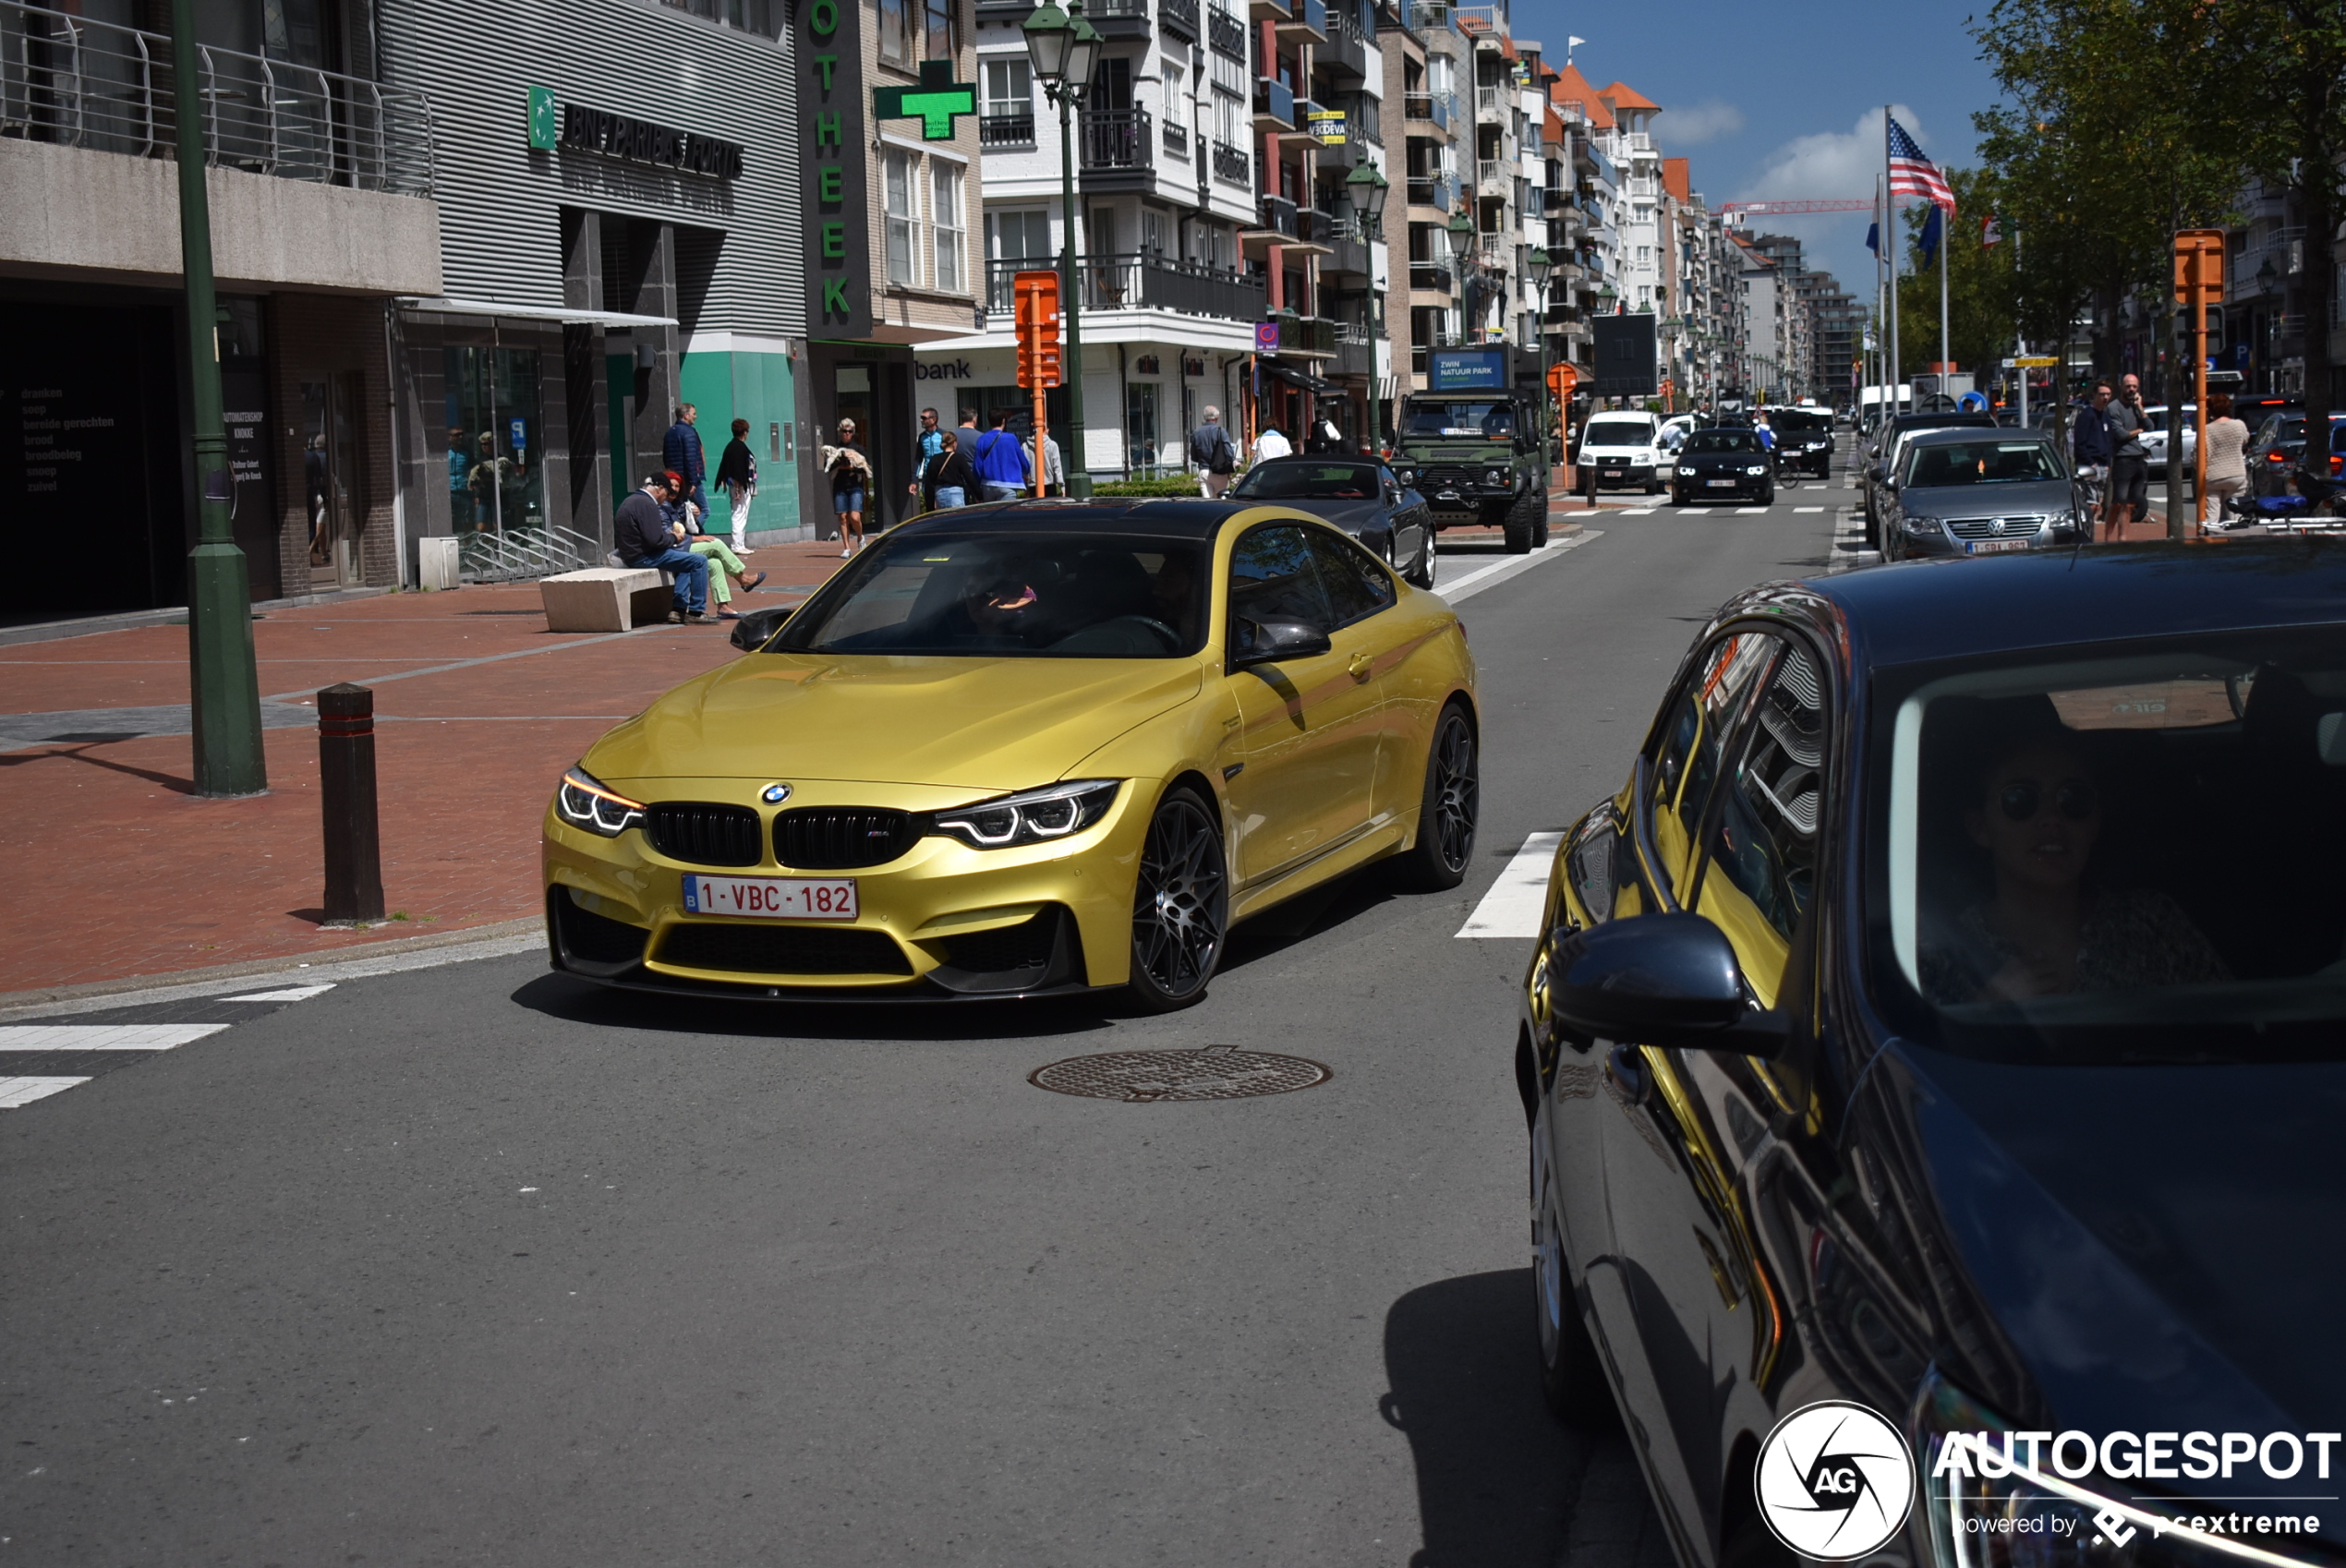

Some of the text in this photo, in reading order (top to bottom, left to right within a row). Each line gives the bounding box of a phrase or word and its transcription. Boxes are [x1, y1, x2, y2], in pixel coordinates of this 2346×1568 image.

[1324, 124, 1345, 135] DEVA
[570, 105, 744, 179] BNP PARIBAS FORTIS
[914, 358, 972, 380] bank
[1440, 360, 1459, 368] ZWIN
[1440, 367, 1493, 376] NATUUR PARK
[21, 388, 63, 399] dranken
[22, 405, 46, 416] soep
[23, 416, 115, 430] bereide gerechten
[224, 412, 263, 423] AUTOMATENSHOP
[234, 428, 254, 439] KNOKKE
[24, 434, 54, 445] brood
[25, 449, 81, 461] broodbeleg
[26, 467, 57, 477] snoep
[28, 481, 57, 491] zuivel
[686, 883, 851, 912] B 1-VBC-182
